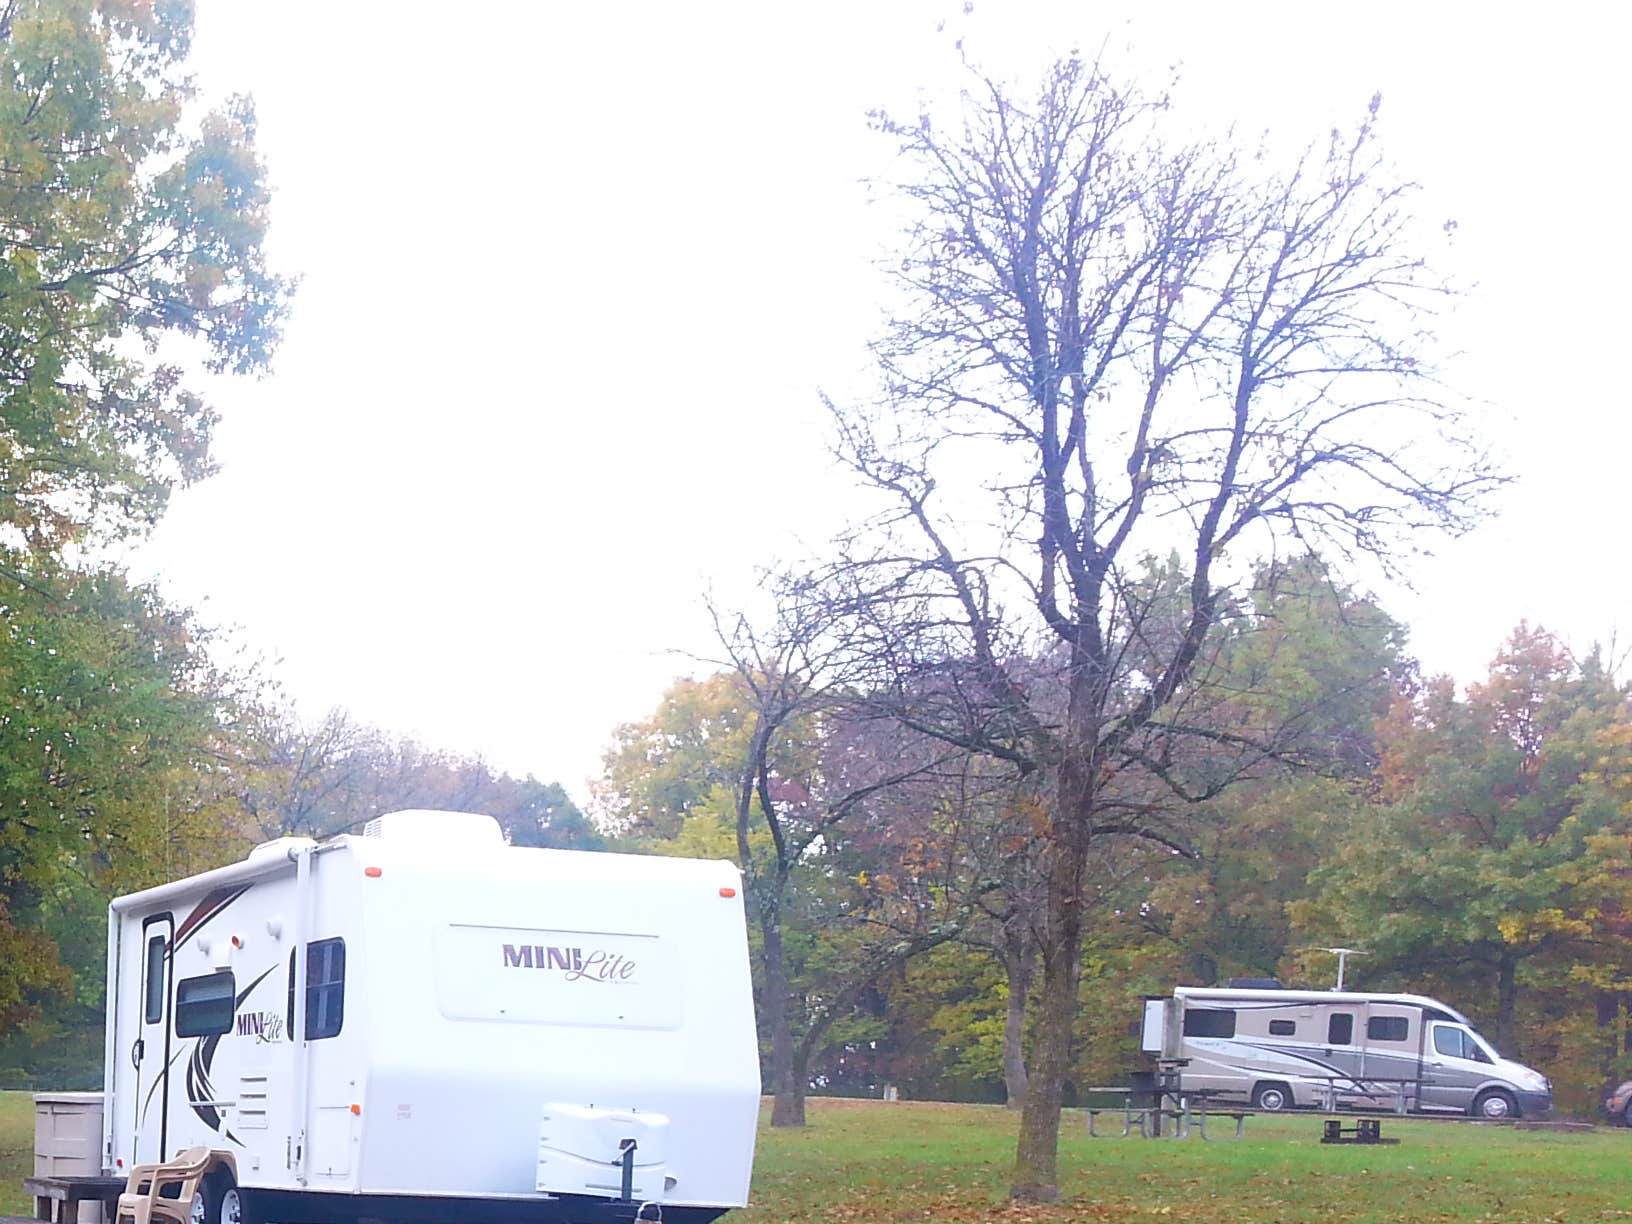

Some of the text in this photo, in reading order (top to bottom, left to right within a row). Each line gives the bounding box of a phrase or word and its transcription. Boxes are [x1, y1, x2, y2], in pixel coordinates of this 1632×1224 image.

[502, 943, 635, 982] MINI Lite
[256, 1012, 283, 1044] Lite
